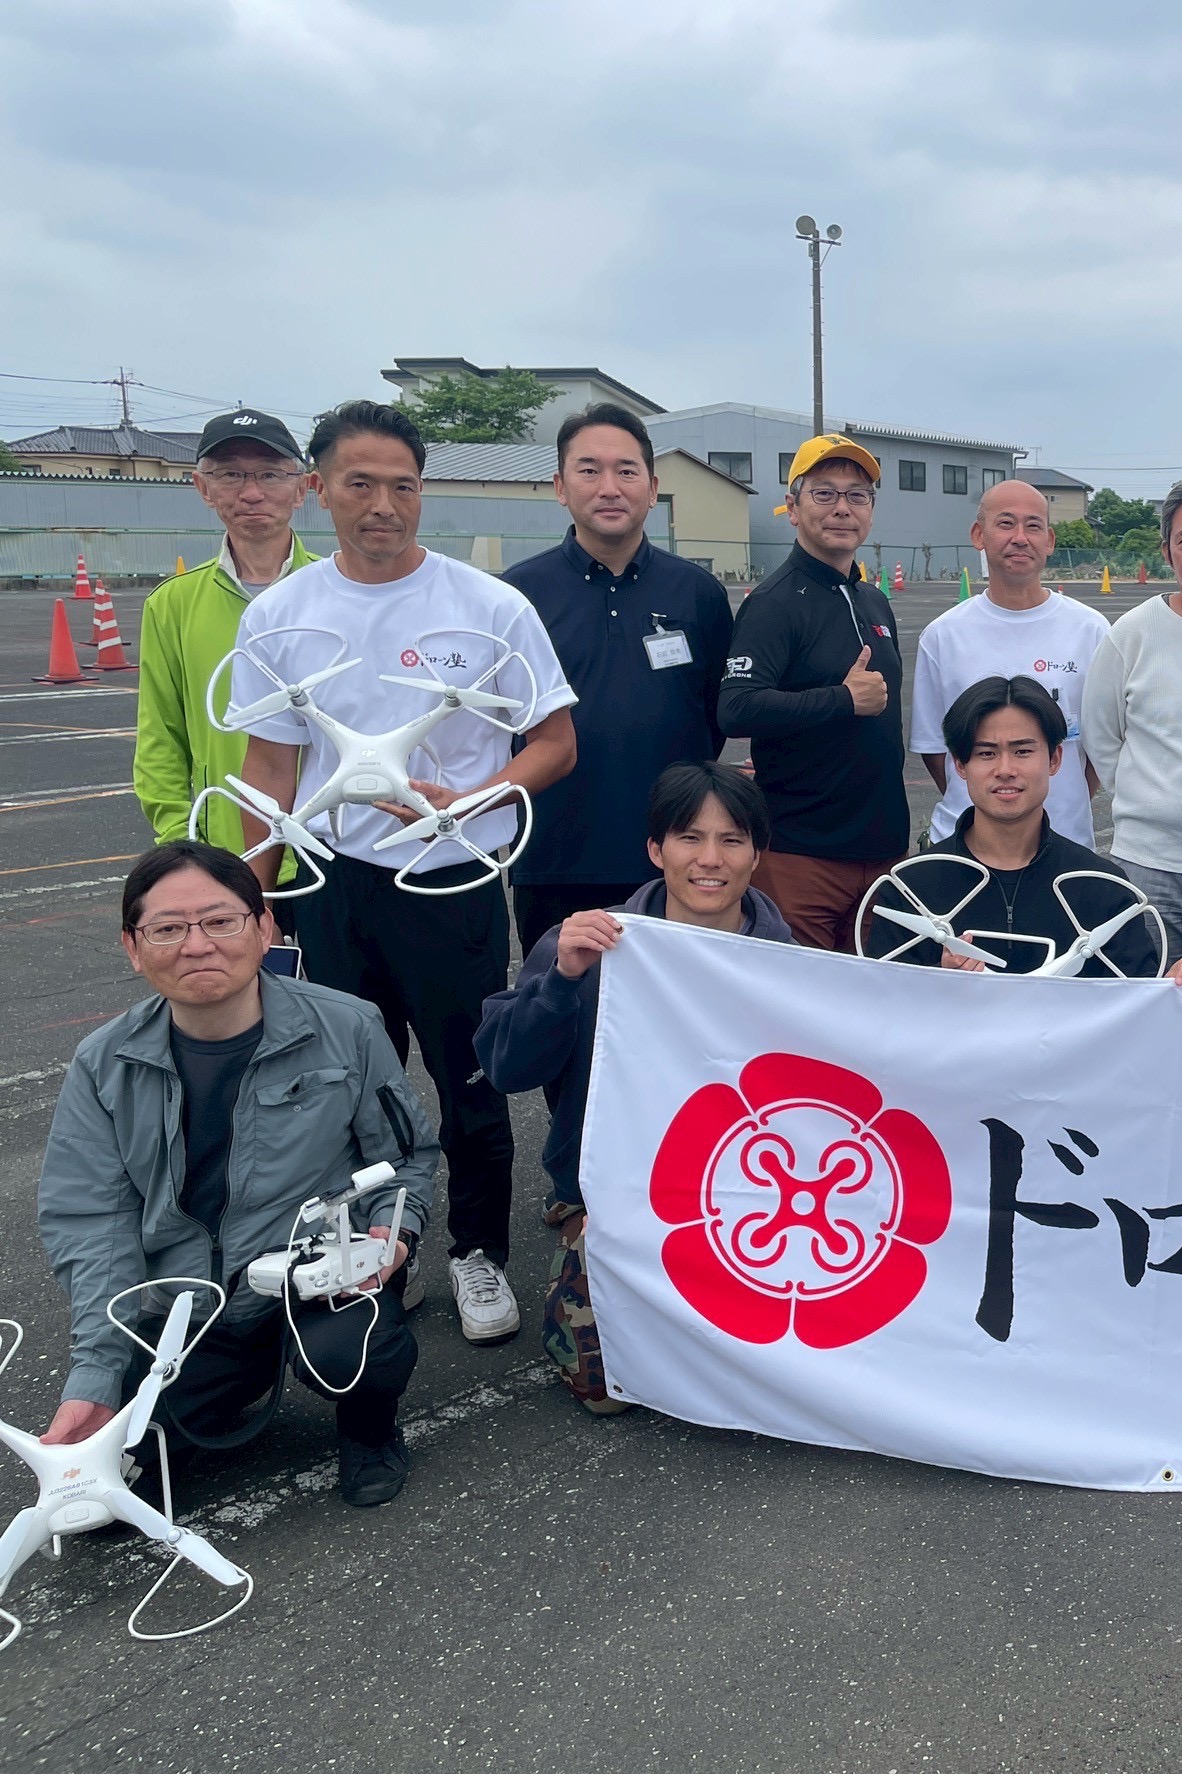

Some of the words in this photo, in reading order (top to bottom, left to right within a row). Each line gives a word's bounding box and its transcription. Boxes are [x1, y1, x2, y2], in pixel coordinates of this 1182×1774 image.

[1047, 661, 1078, 673] ドローン塾
